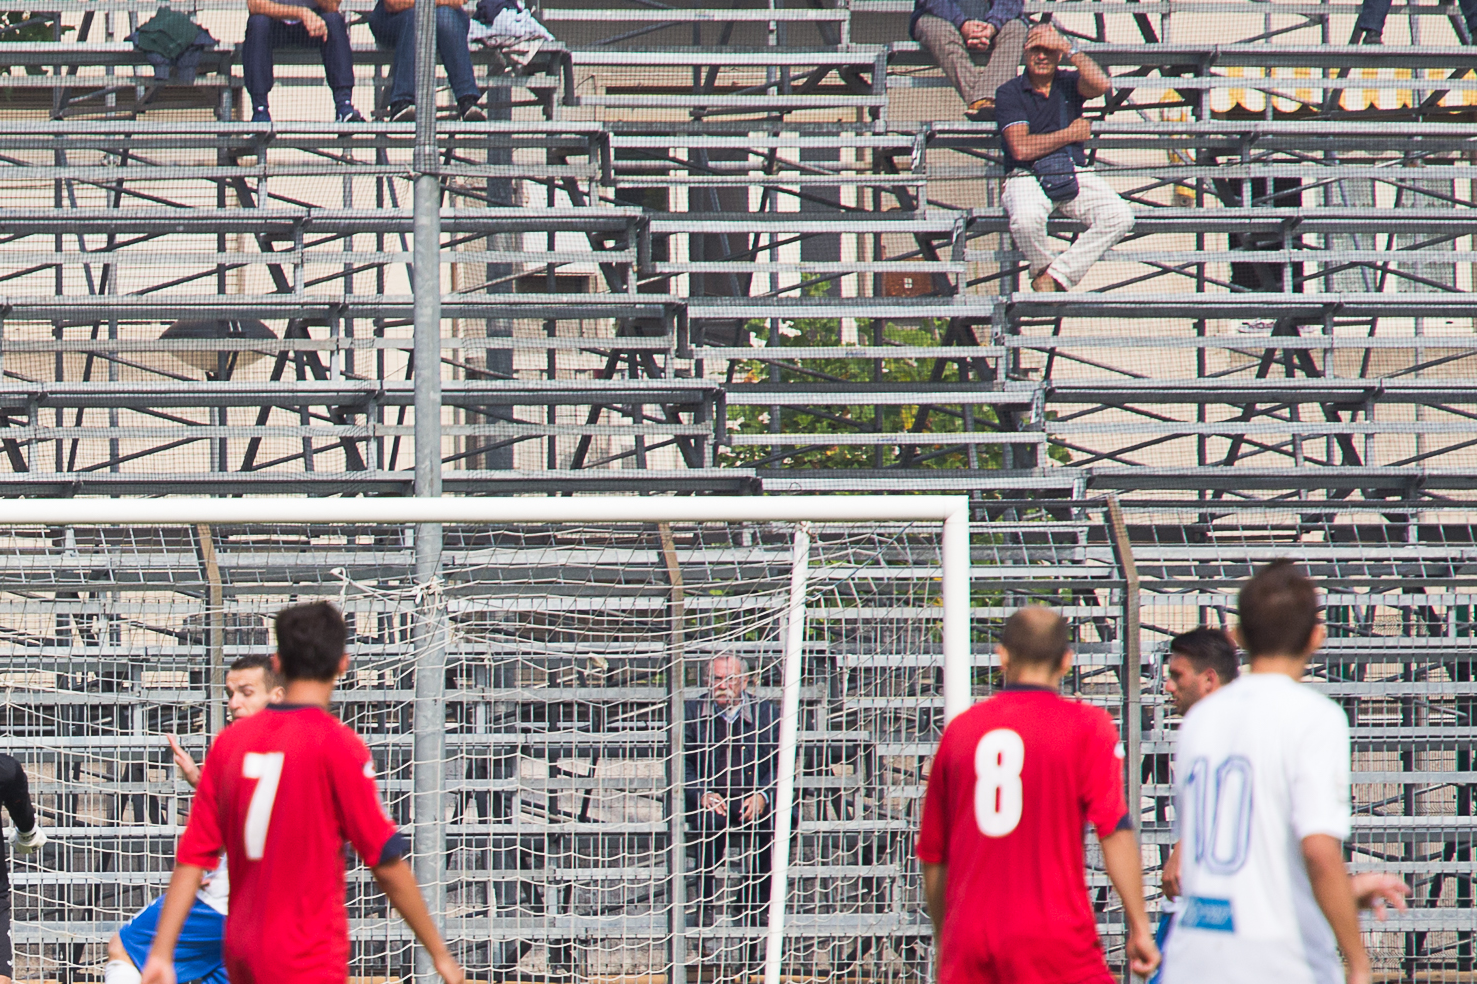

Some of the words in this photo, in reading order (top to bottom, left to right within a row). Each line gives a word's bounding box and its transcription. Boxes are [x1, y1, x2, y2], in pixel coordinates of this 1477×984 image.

[242, 752, 285, 861] 7
[975, 728, 1024, 838] 8
[1184, 755, 1254, 876] 10
